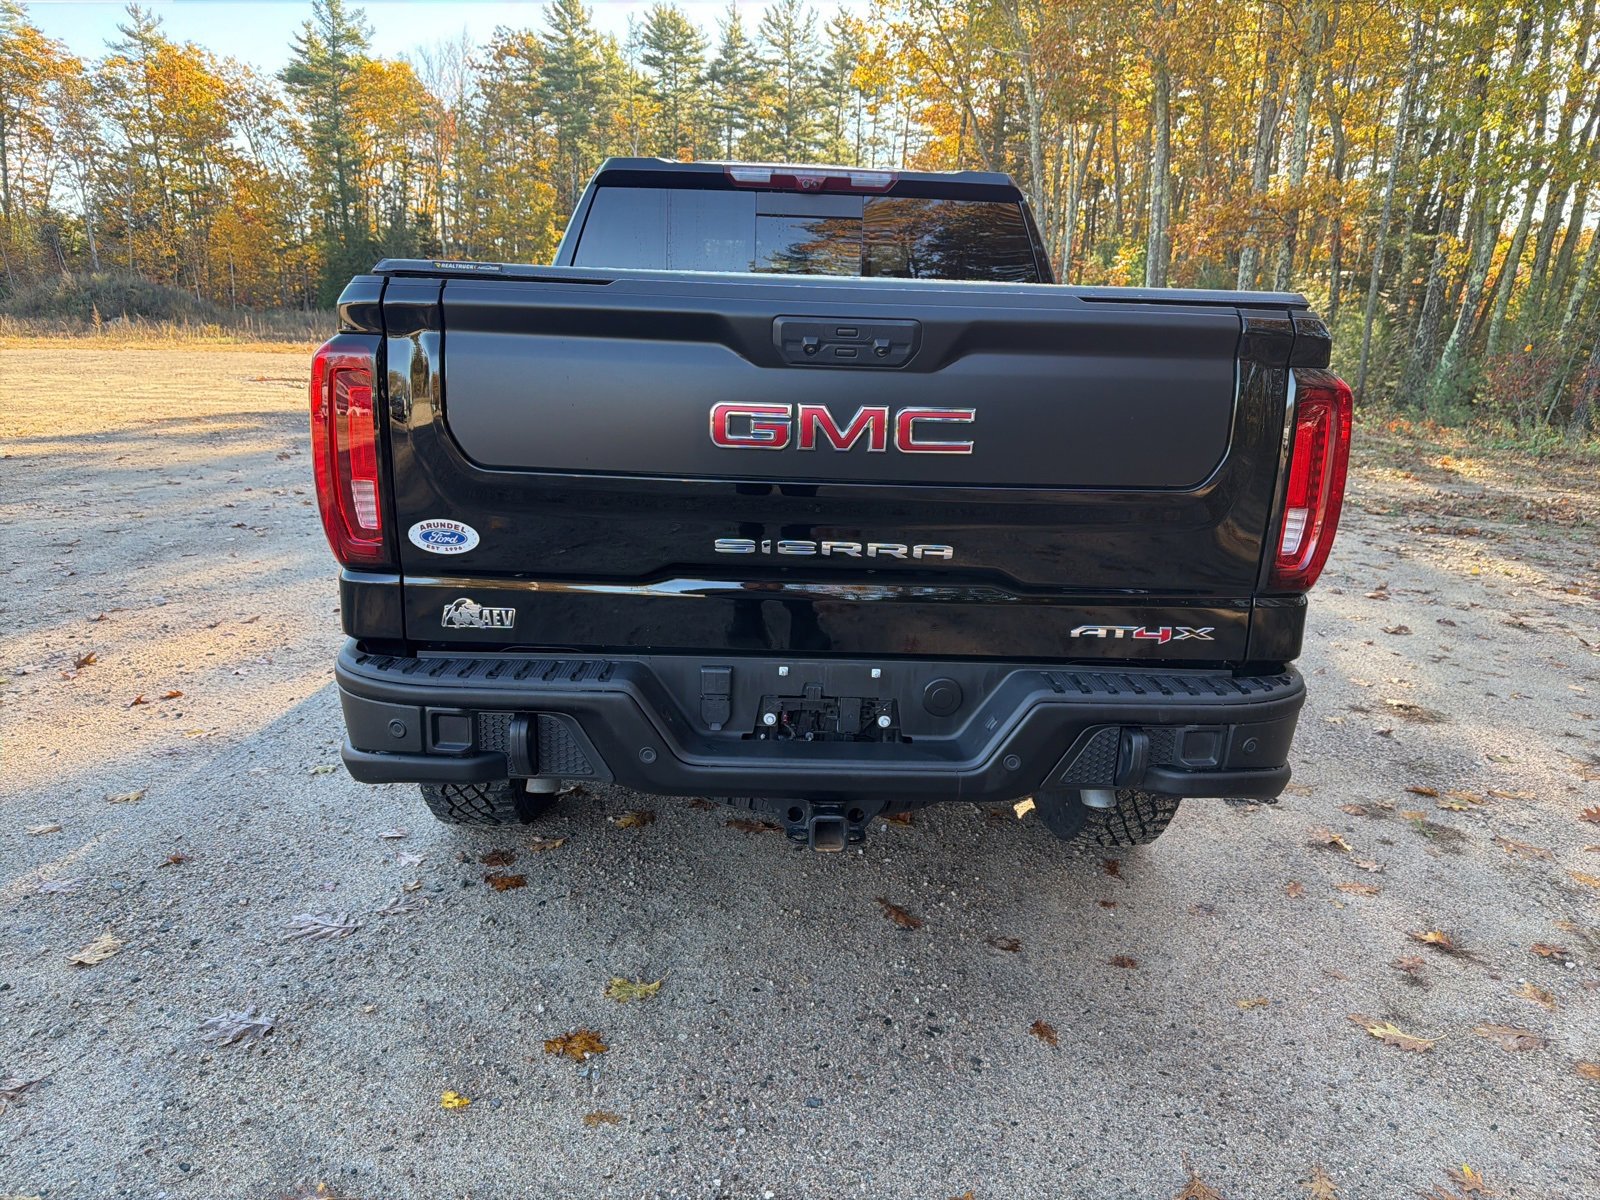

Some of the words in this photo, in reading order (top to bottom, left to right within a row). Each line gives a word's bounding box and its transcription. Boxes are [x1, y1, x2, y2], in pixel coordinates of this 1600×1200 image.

[709, 400, 976, 454] GMC
[420, 522, 466, 533] ARUNDEL
[428, 531, 459, 544] Ford
[714, 538, 953, 560] SIERRA
[481, 610, 513, 626] AEV
[1070, 625, 1215, 645] AT4X
